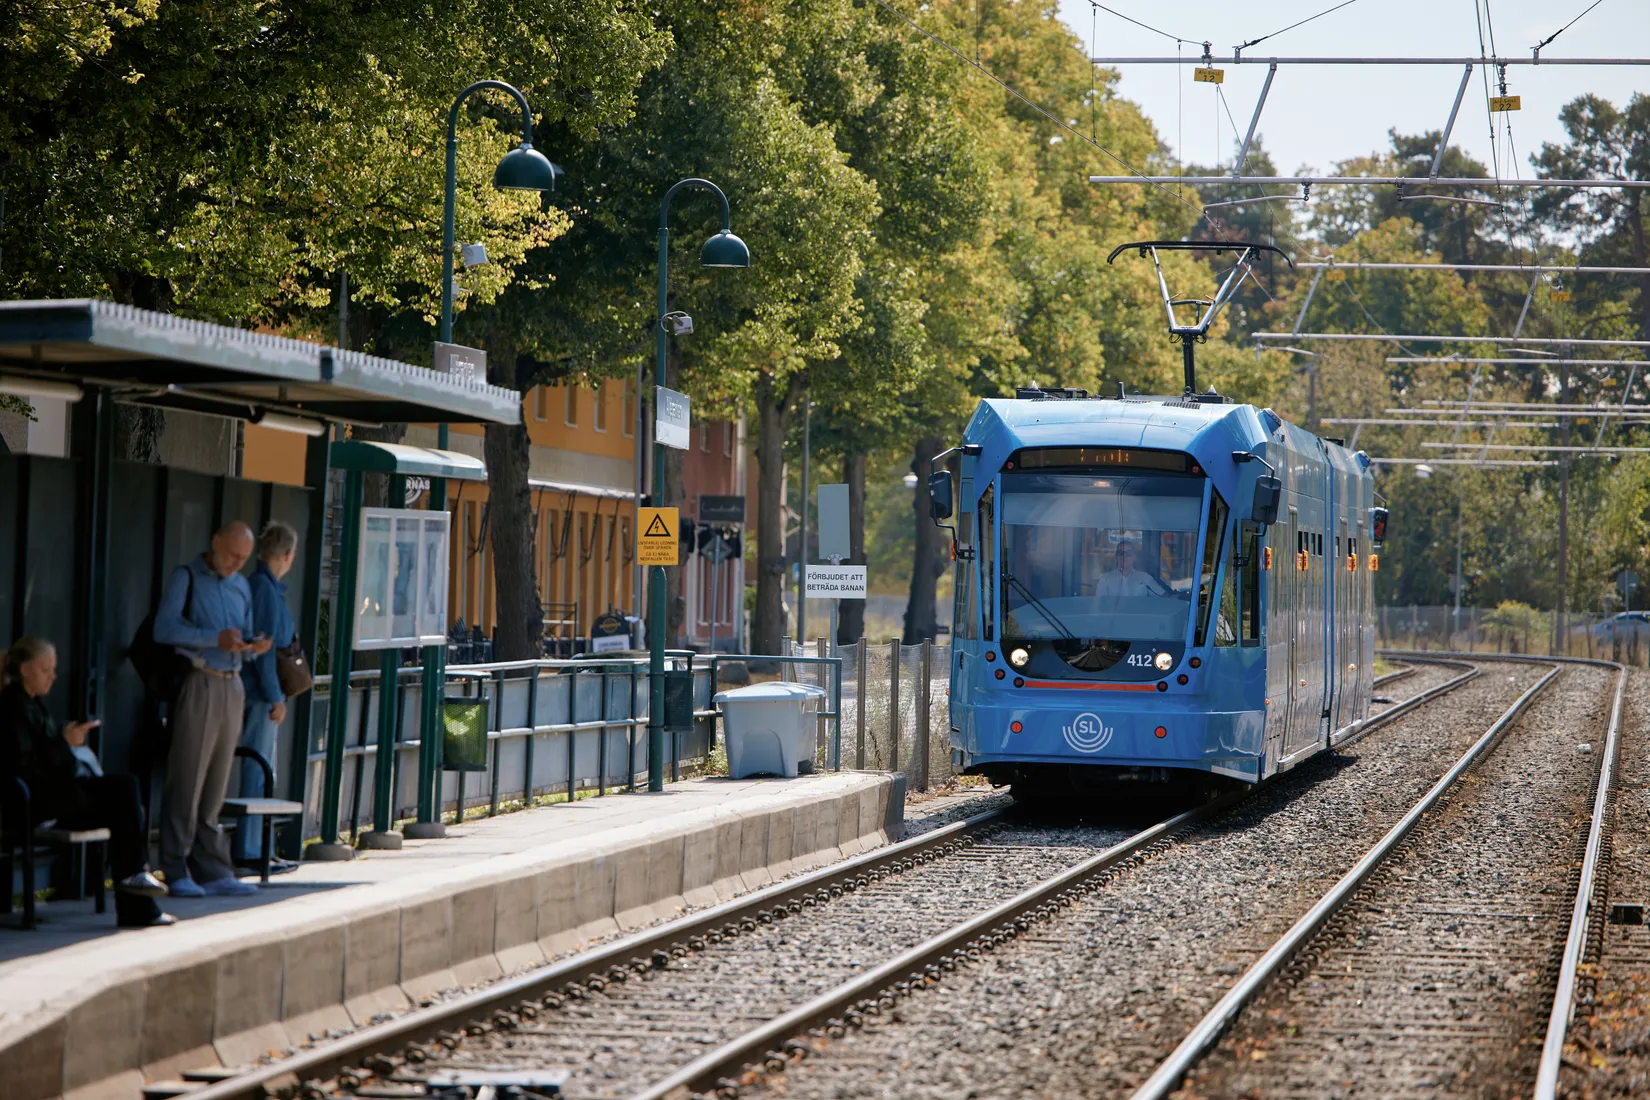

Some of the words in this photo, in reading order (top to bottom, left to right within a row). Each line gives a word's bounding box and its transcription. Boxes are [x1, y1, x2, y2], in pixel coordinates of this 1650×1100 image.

[807, 571, 848, 580] FÖRBJUDET
[807, 583, 839, 591] BETRÄDA
[1127, 654, 1152, 667] 412
[1079, 720, 1097, 734] SL
